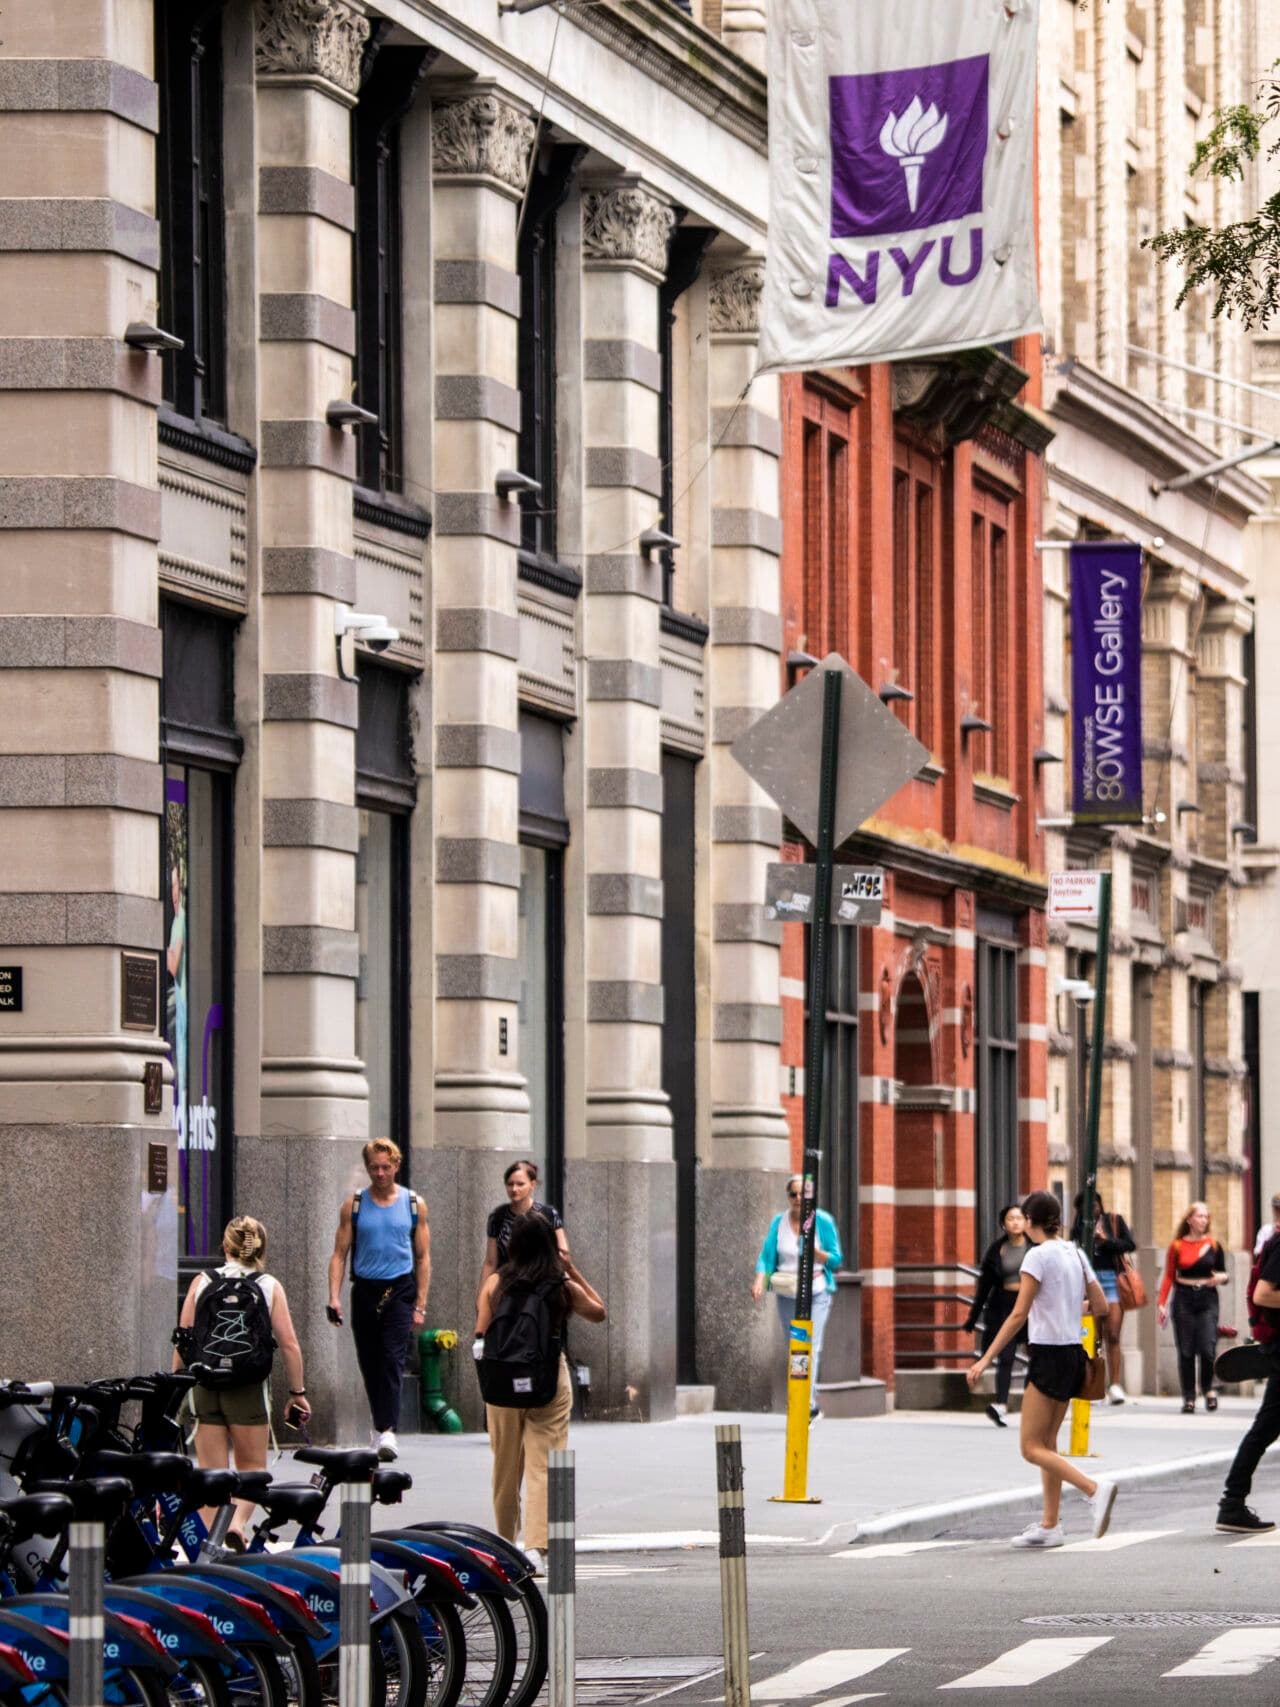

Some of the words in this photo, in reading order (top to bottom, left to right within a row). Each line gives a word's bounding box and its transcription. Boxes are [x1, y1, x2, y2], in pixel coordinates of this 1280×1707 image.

[824, 227, 983, 308] NYU
[1094, 568, 1128, 677] Gallery
[180, 1518, 199, 1547] ike
[307, 1594, 335, 1613] ike
